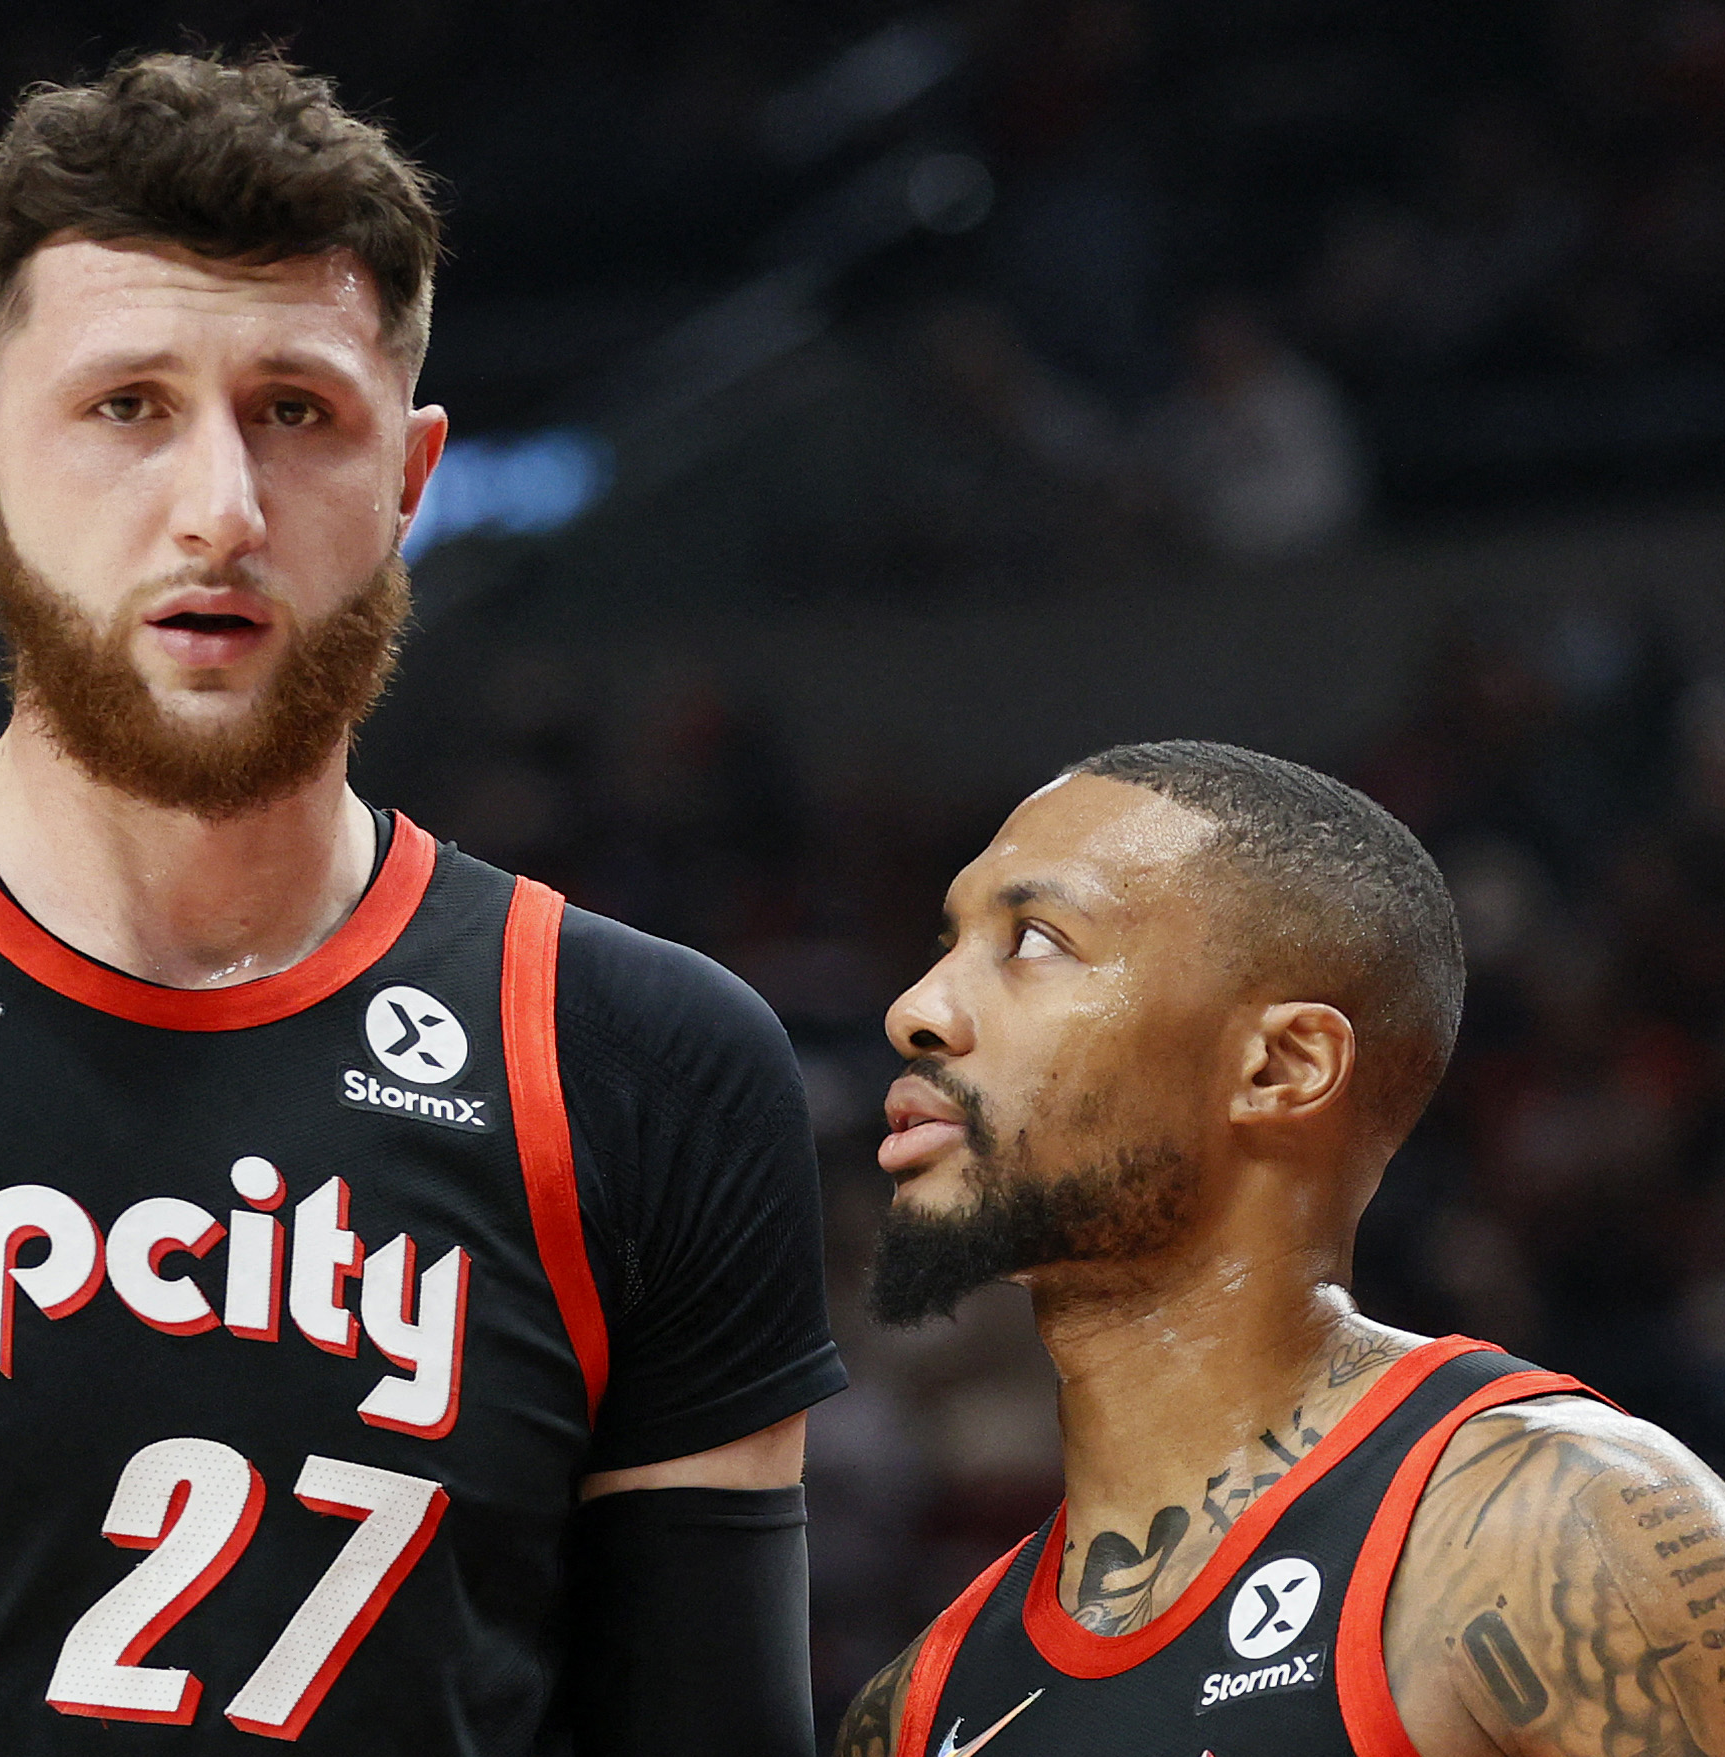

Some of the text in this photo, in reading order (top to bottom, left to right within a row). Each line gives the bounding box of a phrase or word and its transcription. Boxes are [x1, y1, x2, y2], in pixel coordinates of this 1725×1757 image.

[344, 1069, 486, 1126] StormX
[44, 1437, 451, 1742] 27
[1201, 1653, 1319, 1706] StormX
